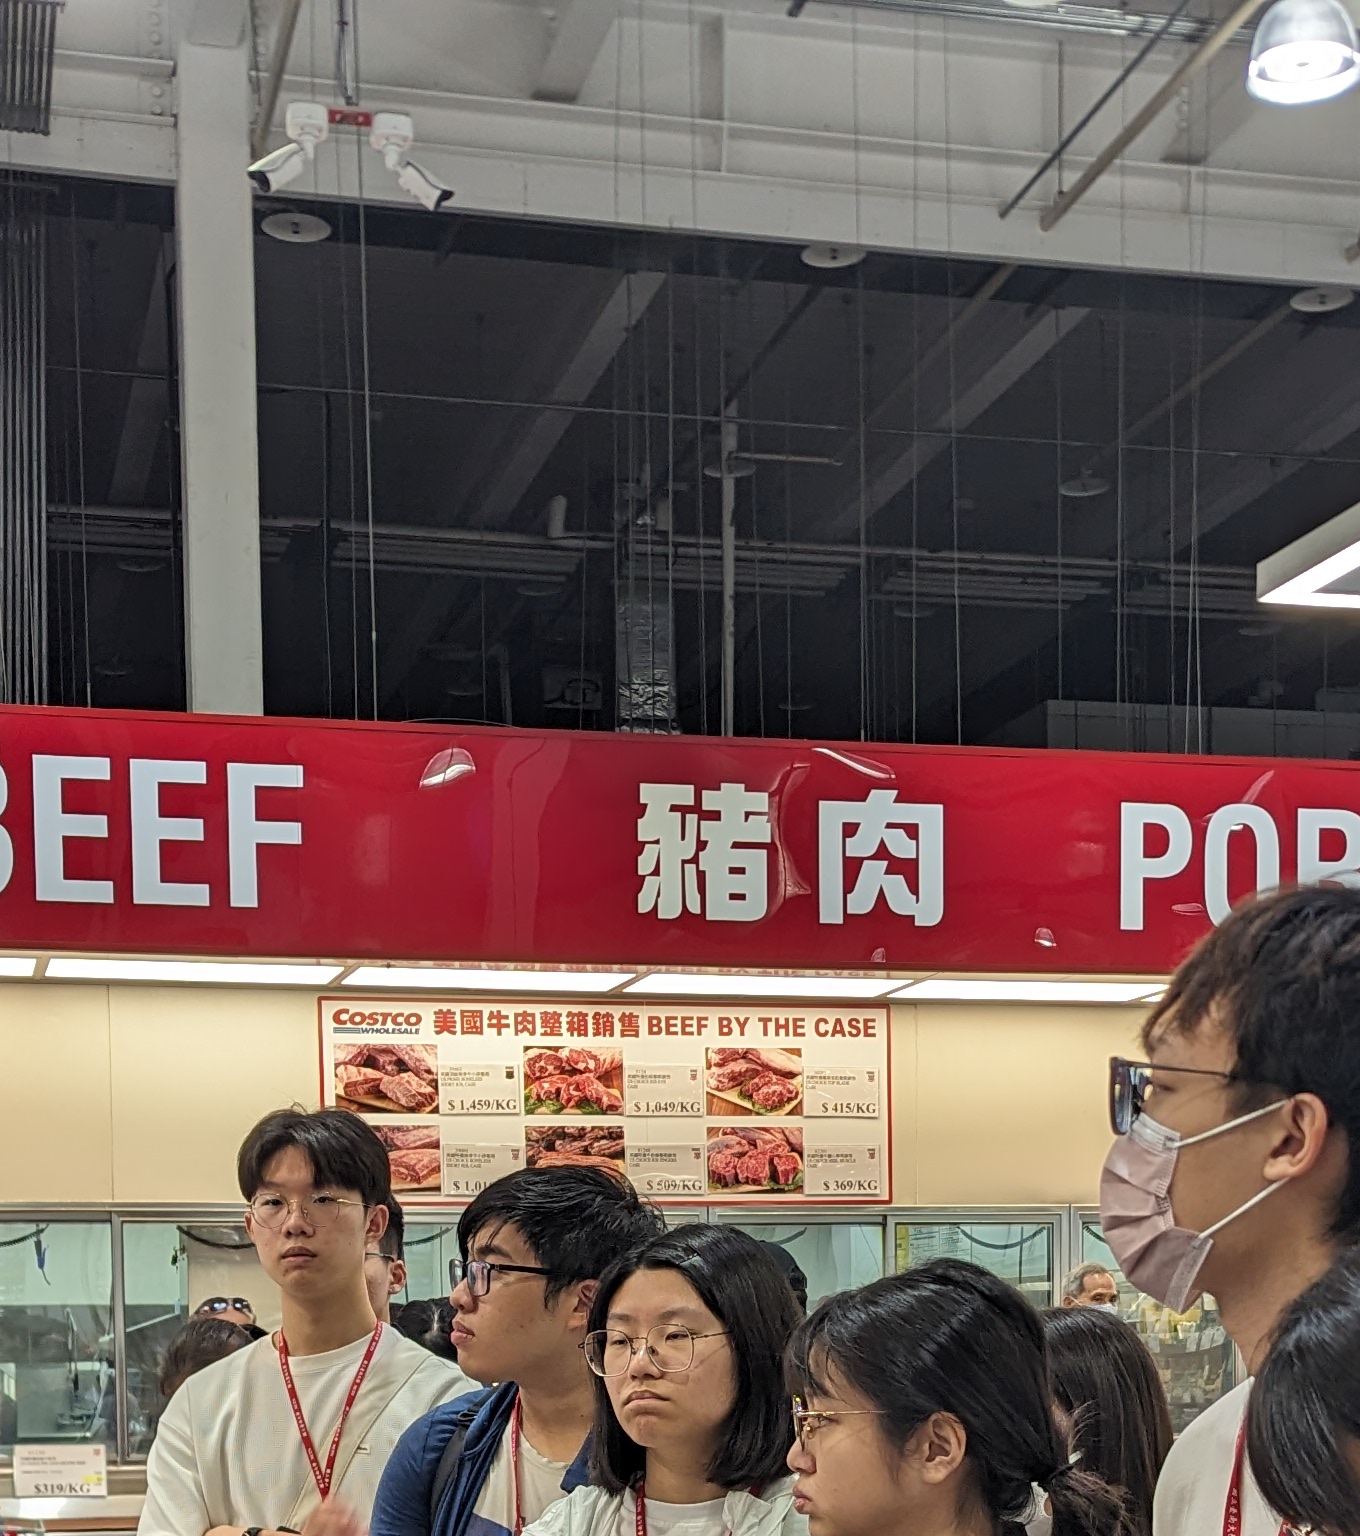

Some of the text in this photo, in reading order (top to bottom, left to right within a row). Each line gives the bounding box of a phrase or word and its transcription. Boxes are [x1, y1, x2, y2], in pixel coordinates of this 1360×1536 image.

[637, 781, 944, 928] 豬肉
[332, 1008, 422, 1027] COSTCO
[433, 1008, 876, 1038] 美國牛肉整箱銷售 BEEF BY THE CASE
[360, 1027, 420, 1035] WHOLESALE
[460, 1099, 517, 1112] 1,459/KG
[645, 1101, 701, 1114] 1,049/KG
[832, 1102, 876, 1114] 415/KG
[833, 1179, 877, 1191] 369/KG
